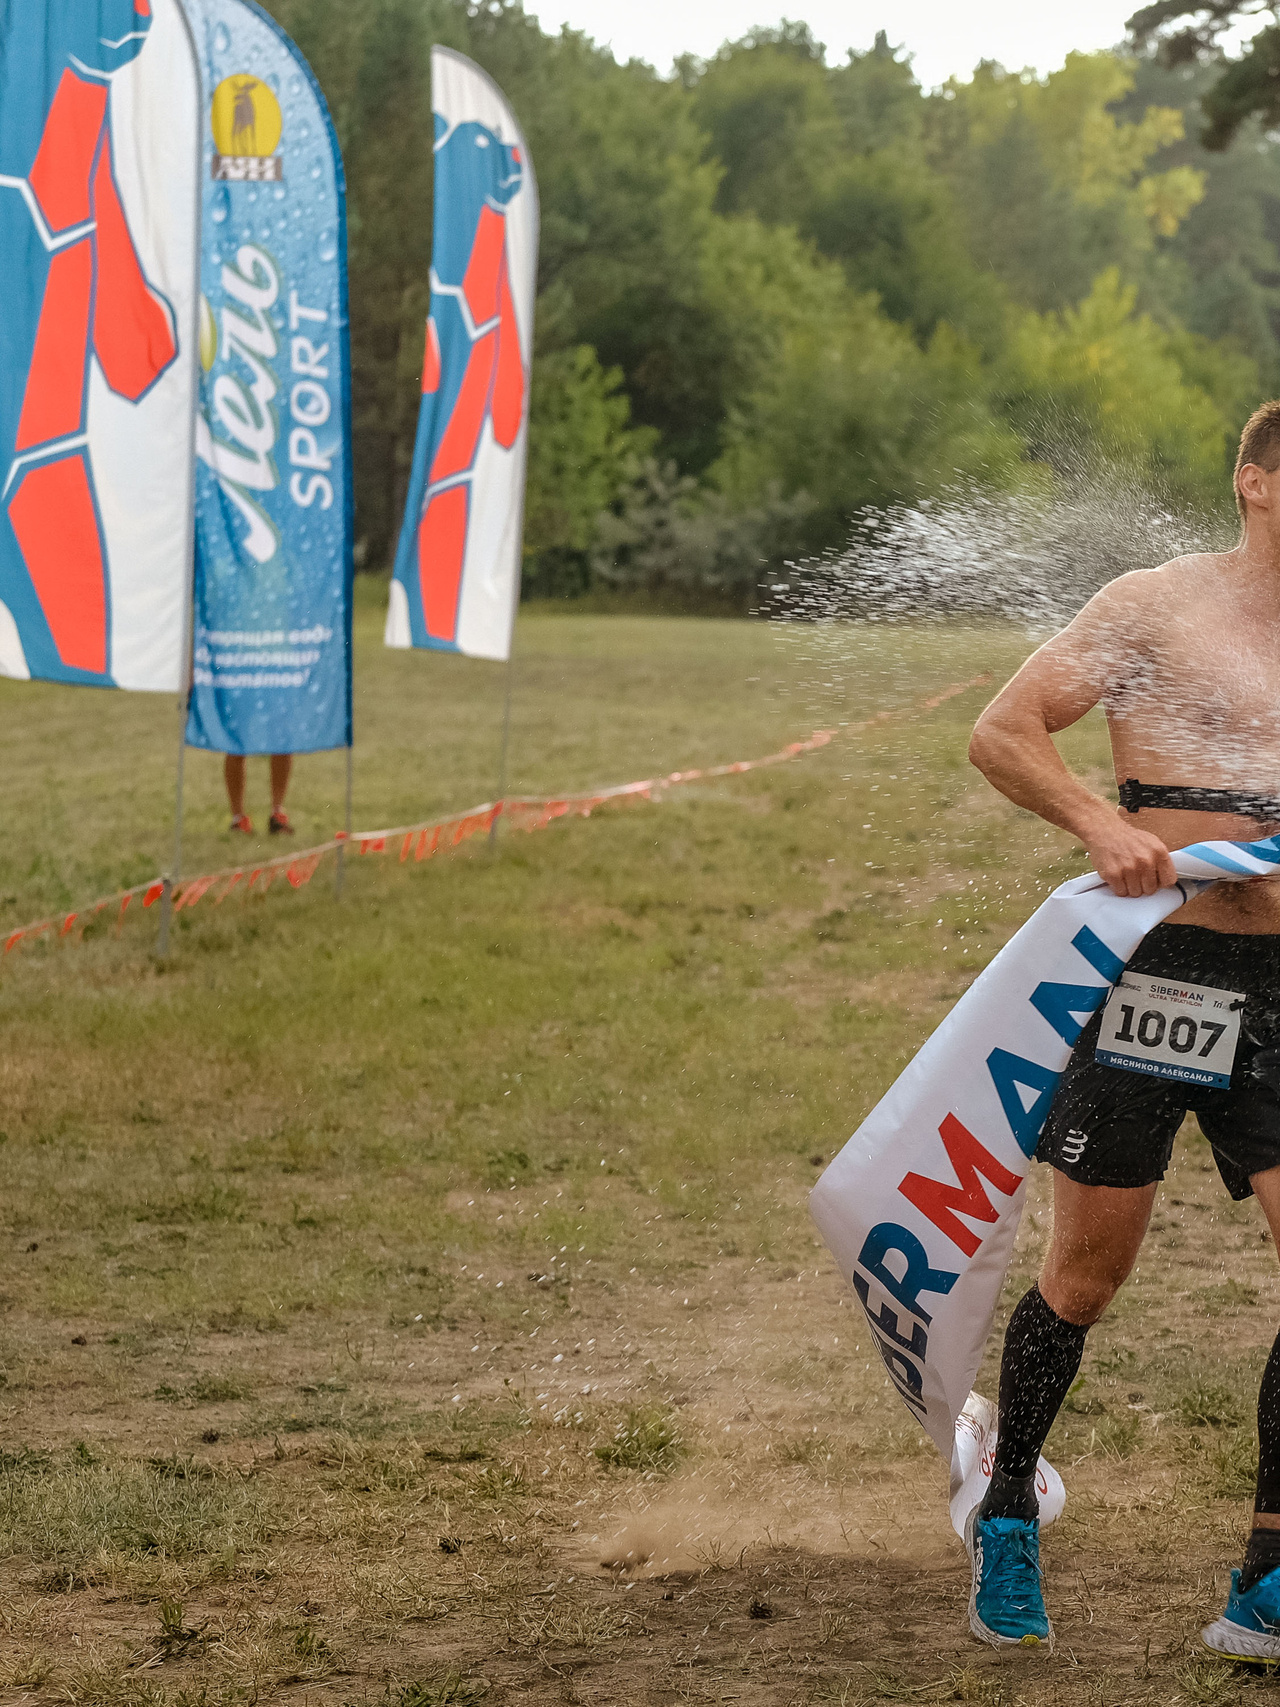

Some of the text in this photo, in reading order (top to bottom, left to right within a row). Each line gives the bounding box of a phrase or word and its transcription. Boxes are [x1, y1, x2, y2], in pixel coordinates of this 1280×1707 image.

[288, 290, 334, 510] SPORT
[1148, 993, 1203, 1008] ULTRA TRIATHLON
[1150, 984, 1205, 1002] SIBERMAN
[1114, 1004, 1228, 1058] 1007
[1110, 1056, 1214, 1083] МЯСНИКОВ АЛЕКСАНДР
